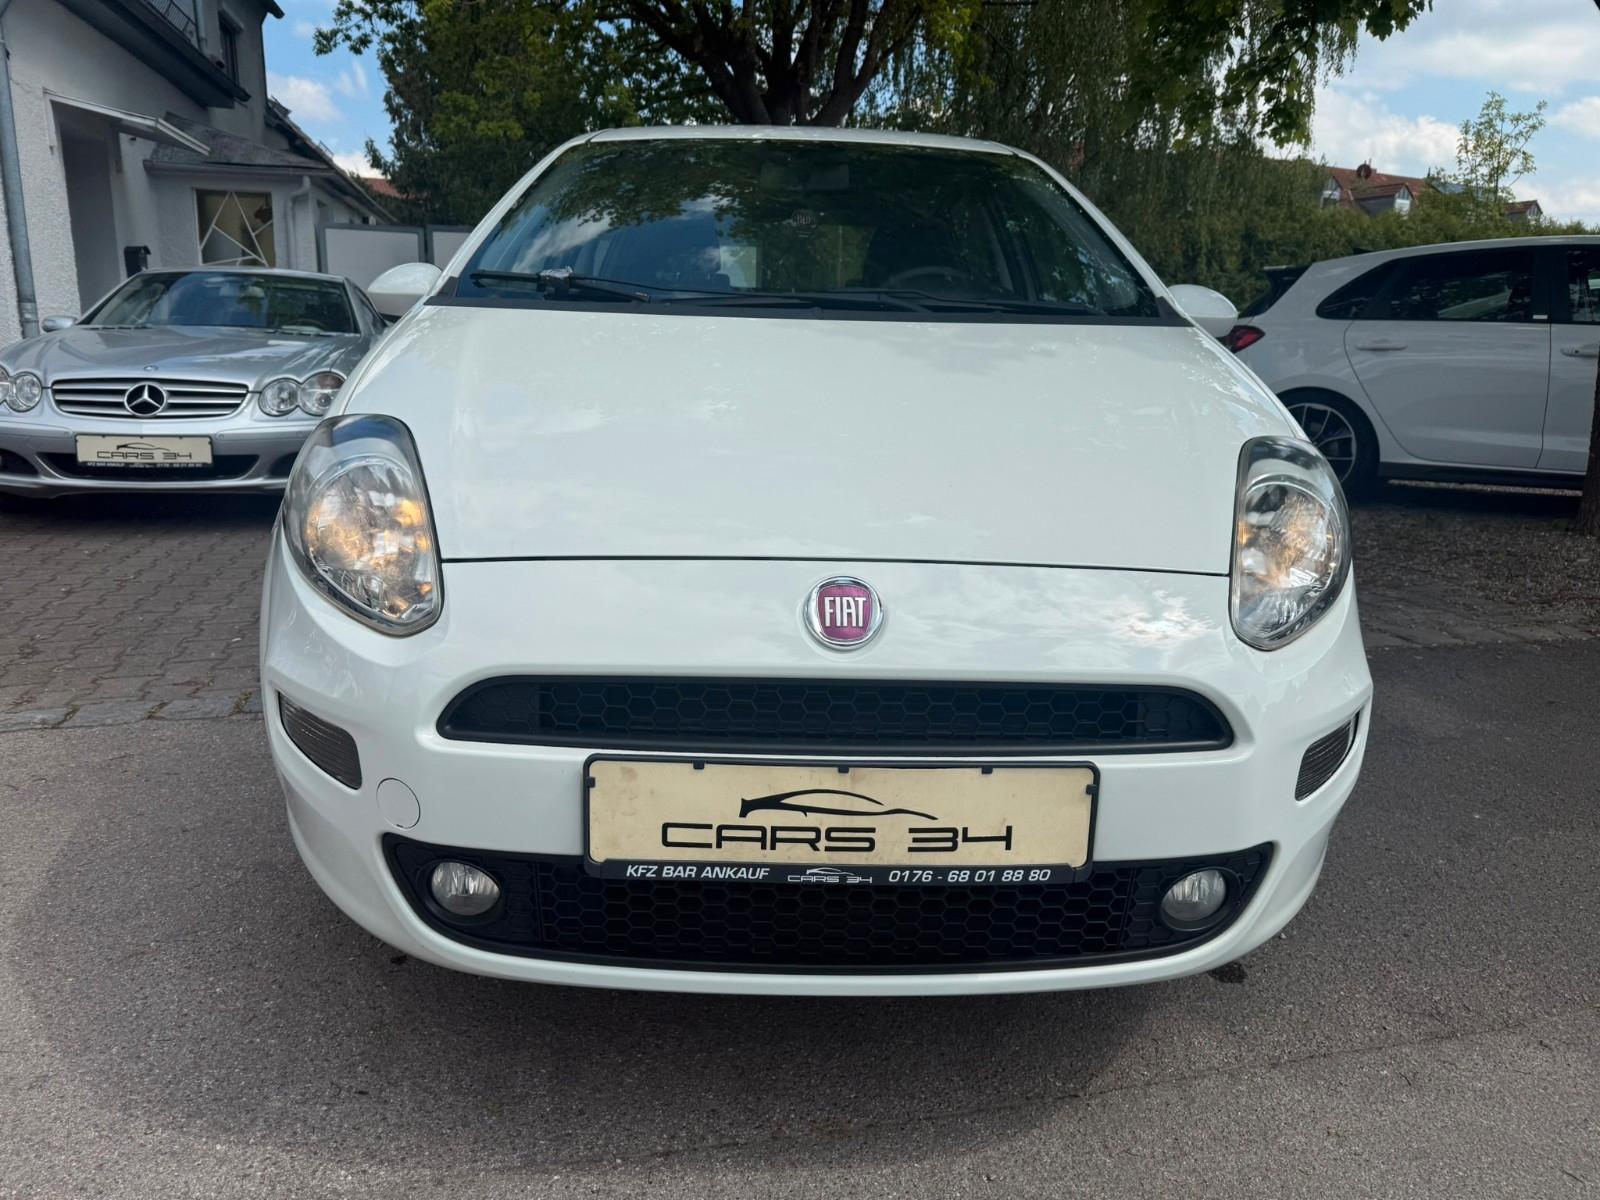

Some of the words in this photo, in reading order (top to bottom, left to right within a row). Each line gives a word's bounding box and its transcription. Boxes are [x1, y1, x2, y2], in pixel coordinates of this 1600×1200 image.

[97, 451, 154, 460] CARS
[163, 451, 192, 460] 34
[824, 596, 867, 628] FIAT
[661, 822, 876, 852] CARS
[908, 825, 1012, 853] 34
[626, 865, 658, 878] KFZ
[661, 866, 697, 878] BAR
[700, 867, 770, 880] ANKAUF
[787, 875, 839, 883] CARS
[846, 876, 873, 884] 34
[888, 870, 933, 883] 0176
[947, 870, 970, 882] 68
[974, 870, 994, 882] 01
[1001, 869, 1024, 882] 88
[1028, 869, 1051, 882] 80
